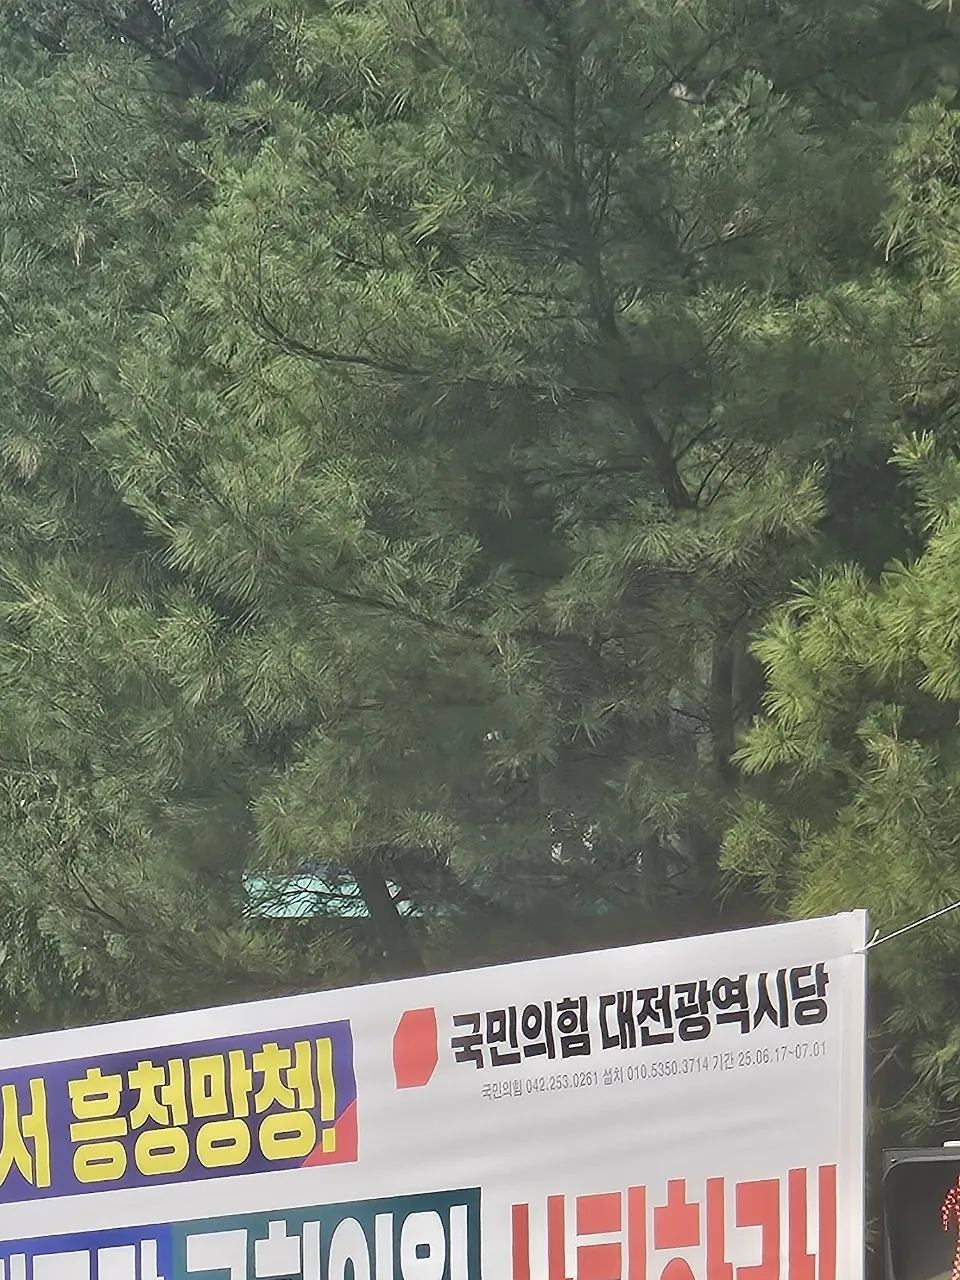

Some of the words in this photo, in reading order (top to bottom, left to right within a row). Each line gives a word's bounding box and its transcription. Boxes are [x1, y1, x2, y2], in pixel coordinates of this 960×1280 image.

[451, 996, 591, 1069] 국민의힘
[599, 962, 830, 1050] 대전광역시당
[68, 1036, 337, 1183] 흥청망청!
[481, 1079, 522, 1100] 국민의힘
[526, 1072, 599, 1093] 042.253.0261
[603, 1066, 624, 1086] 설치
[627, 1054, 709, 1081] 010.5350.3714
[713, 1052, 735, 1071] 기간
